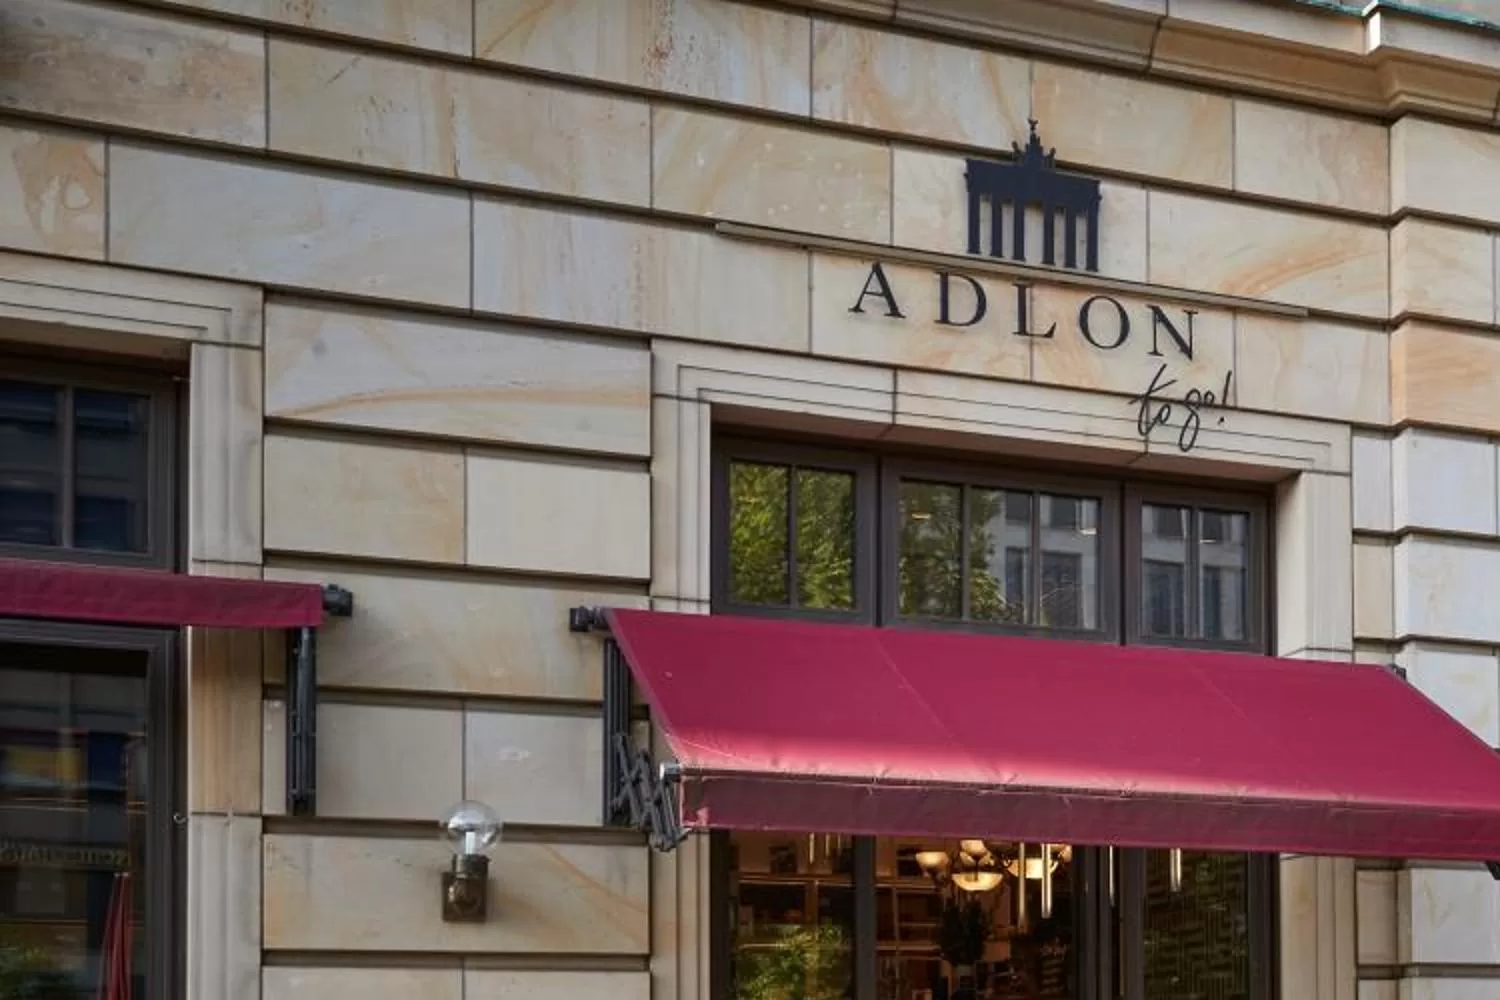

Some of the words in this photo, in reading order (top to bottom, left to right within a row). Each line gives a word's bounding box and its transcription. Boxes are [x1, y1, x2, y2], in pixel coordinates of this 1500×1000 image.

[847, 260, 1199, 361] ADLON
[1129, 364, 1177, 437] to
[1179, 369, 1233, 453] go!
